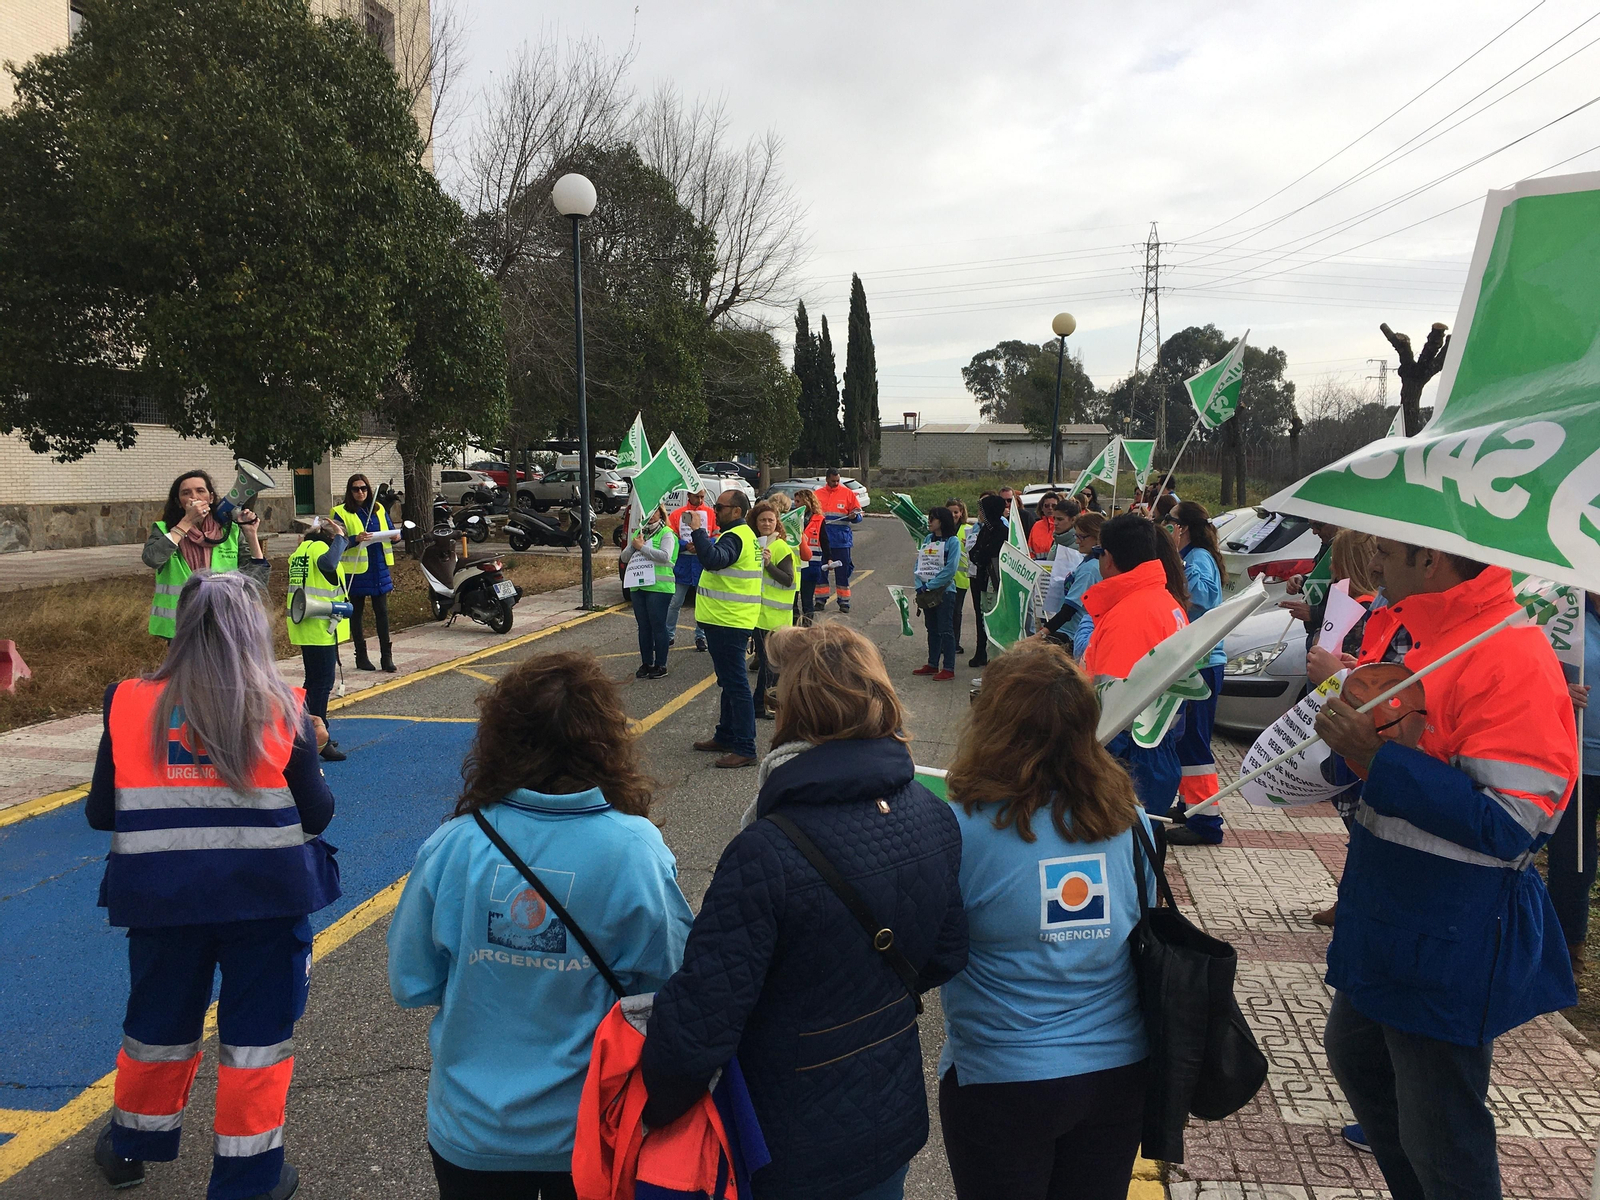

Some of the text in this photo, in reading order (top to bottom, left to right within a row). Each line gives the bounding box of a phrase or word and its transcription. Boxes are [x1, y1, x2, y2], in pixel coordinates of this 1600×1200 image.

[1253, 741, 1274, 763] EFECTIV
[1267, 738, 1298, 770] DESEMEÑO
[167, 767, 218, 779] URGENCI
[1241, 766, 1268, 788] DOLES
[1248, 755, 1279, 784] FESTVOS,
[1039, 928, 1111, 942] URGENCIAS
[468, 948, 592, 972] URGENCIAS
